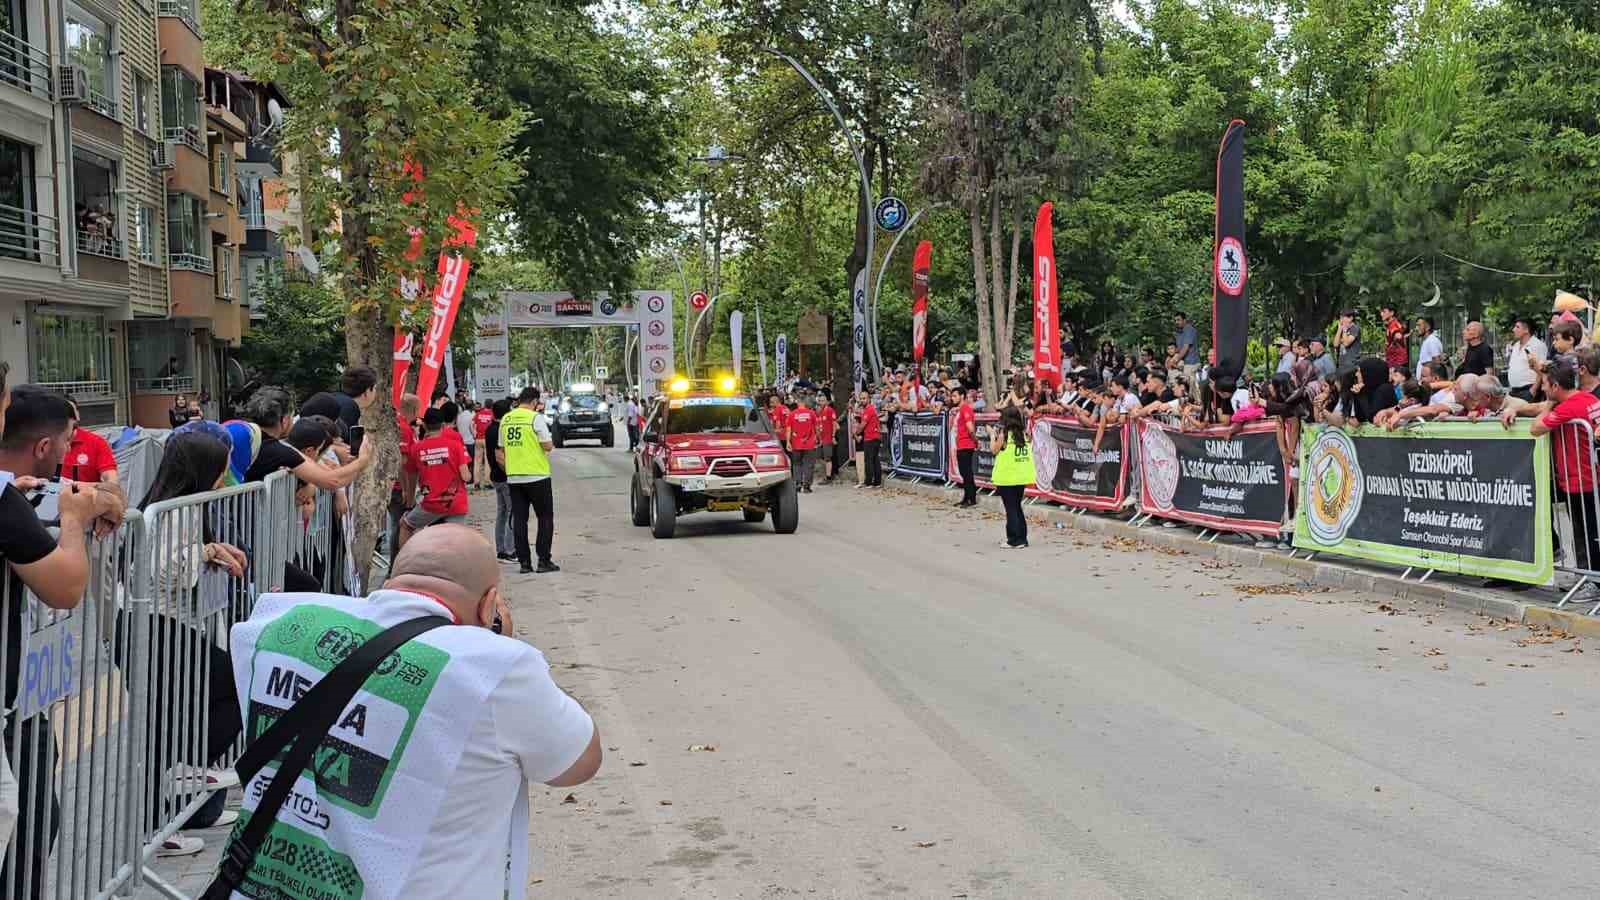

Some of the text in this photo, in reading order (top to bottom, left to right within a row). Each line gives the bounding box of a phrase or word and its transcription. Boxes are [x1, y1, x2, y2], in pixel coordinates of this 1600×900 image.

[507, 427, 522, 440] 85
[1205, 440, 1243, 459] SAMSUN
[1408, 450, 1473, 476] VEZİRKÖPRÜ
[1366, 473, 1533, 507] ORMAN İŞLETME MÜDÜRLÜĞÜNE
[1403, 508, 1484, 531] Teşekkür Ederiz.
[1401, 528, 1422, 541] Samsun
[1423, 531, 1450, 545] Otomobil
[1450, 534, 1462, 546] Spor
[394, 669, 422, 686] FED
[401, 661, 429, 679] TOS
[266, 666, 367, 736] MEA
